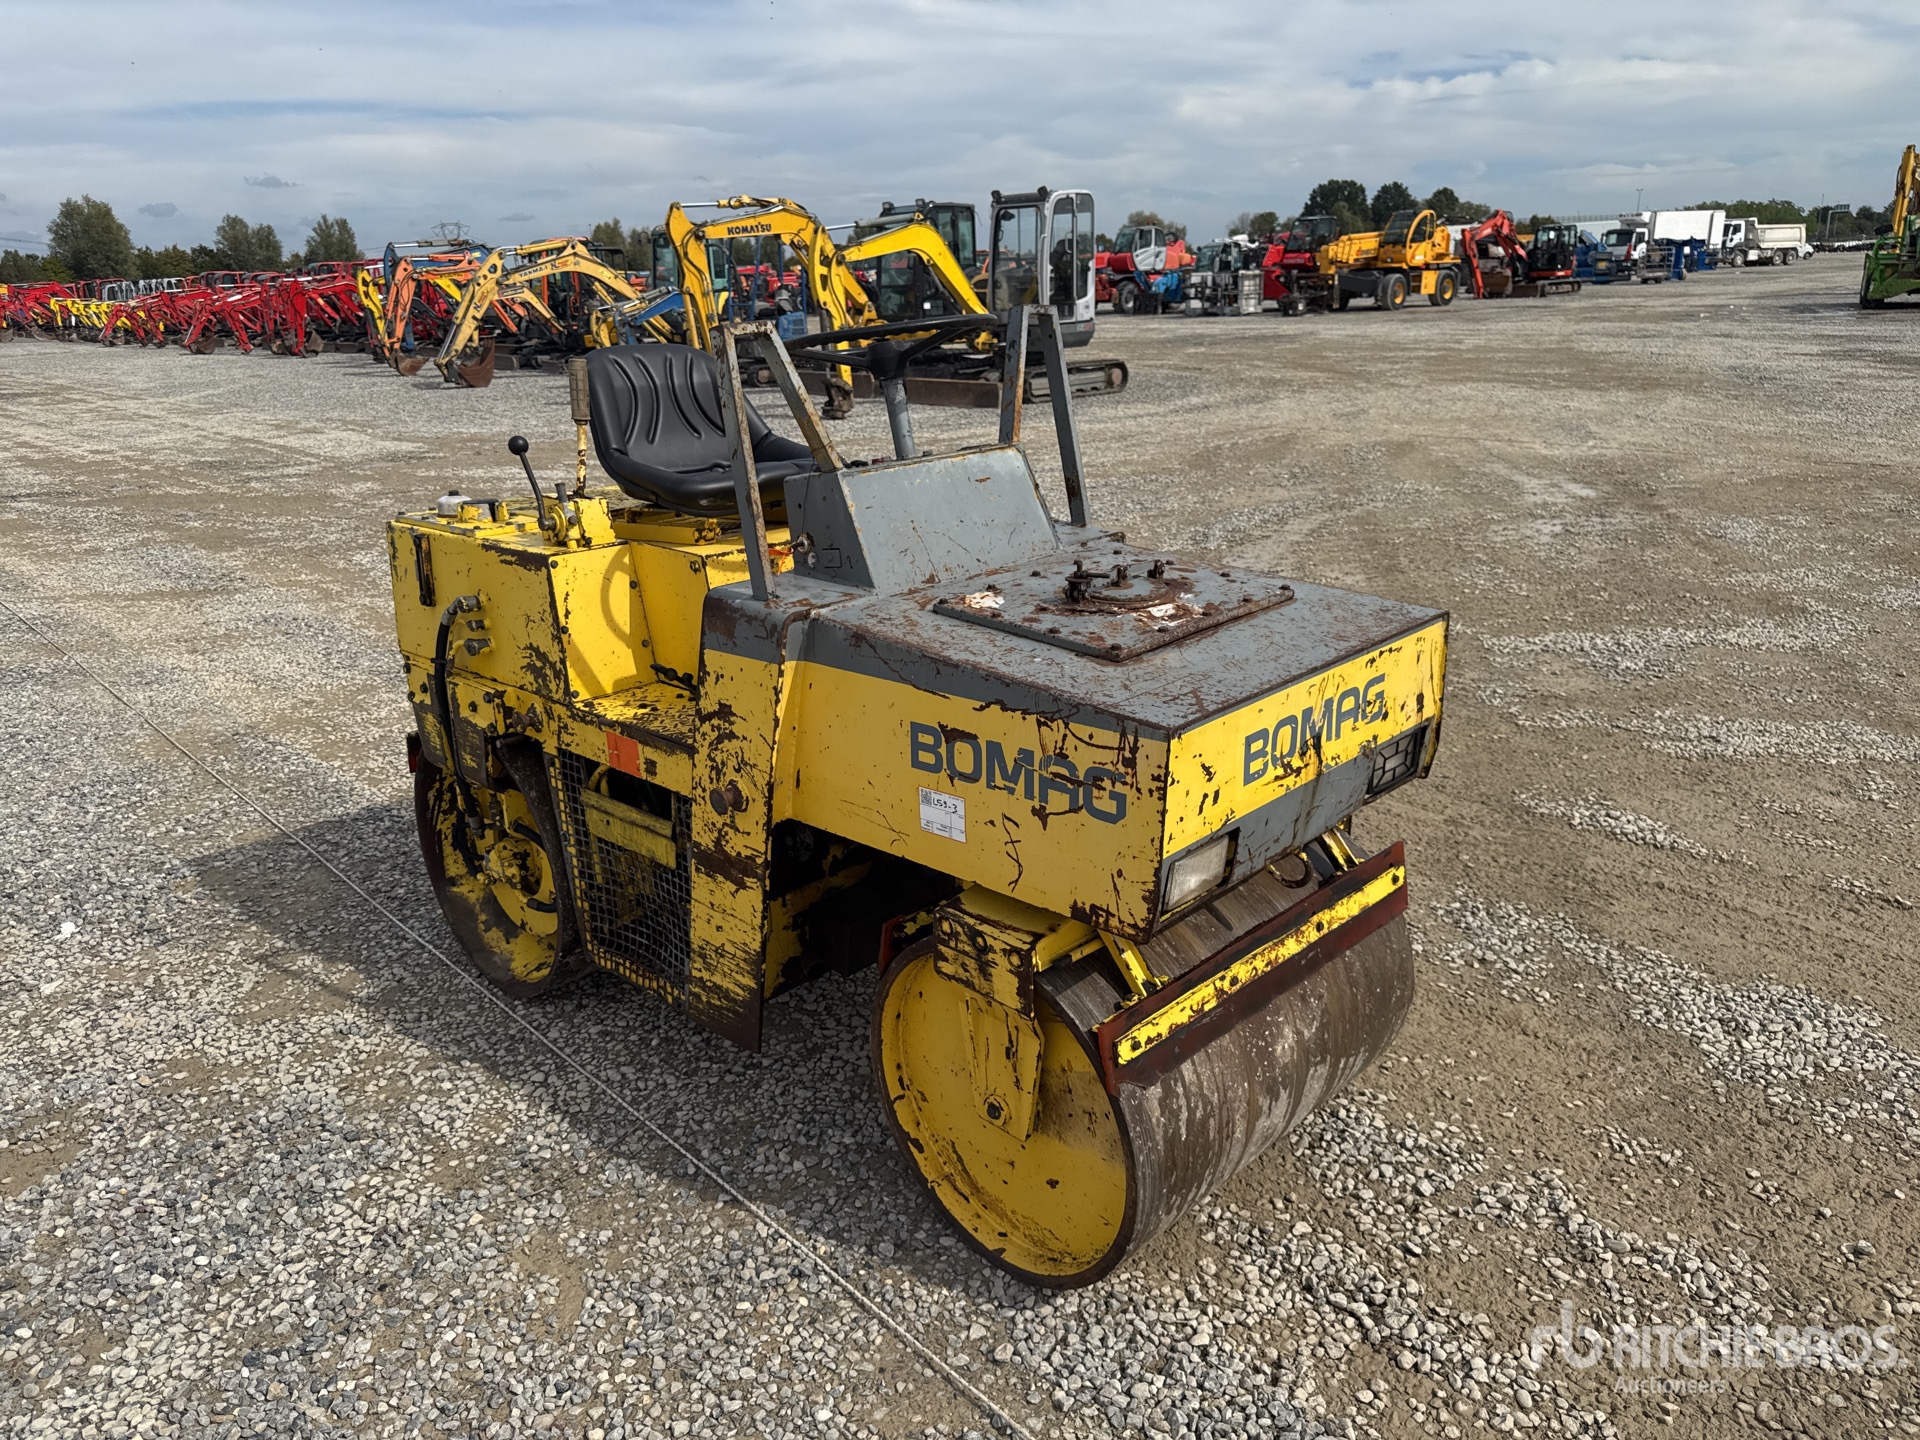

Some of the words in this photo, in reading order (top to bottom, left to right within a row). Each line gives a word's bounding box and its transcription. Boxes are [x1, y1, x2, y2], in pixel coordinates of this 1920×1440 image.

[727, 223, 772, 236] KOMATSU
[910, 721, 1127, 825] BOMAG
[1243, 672, 1386, 787] BOMAG
